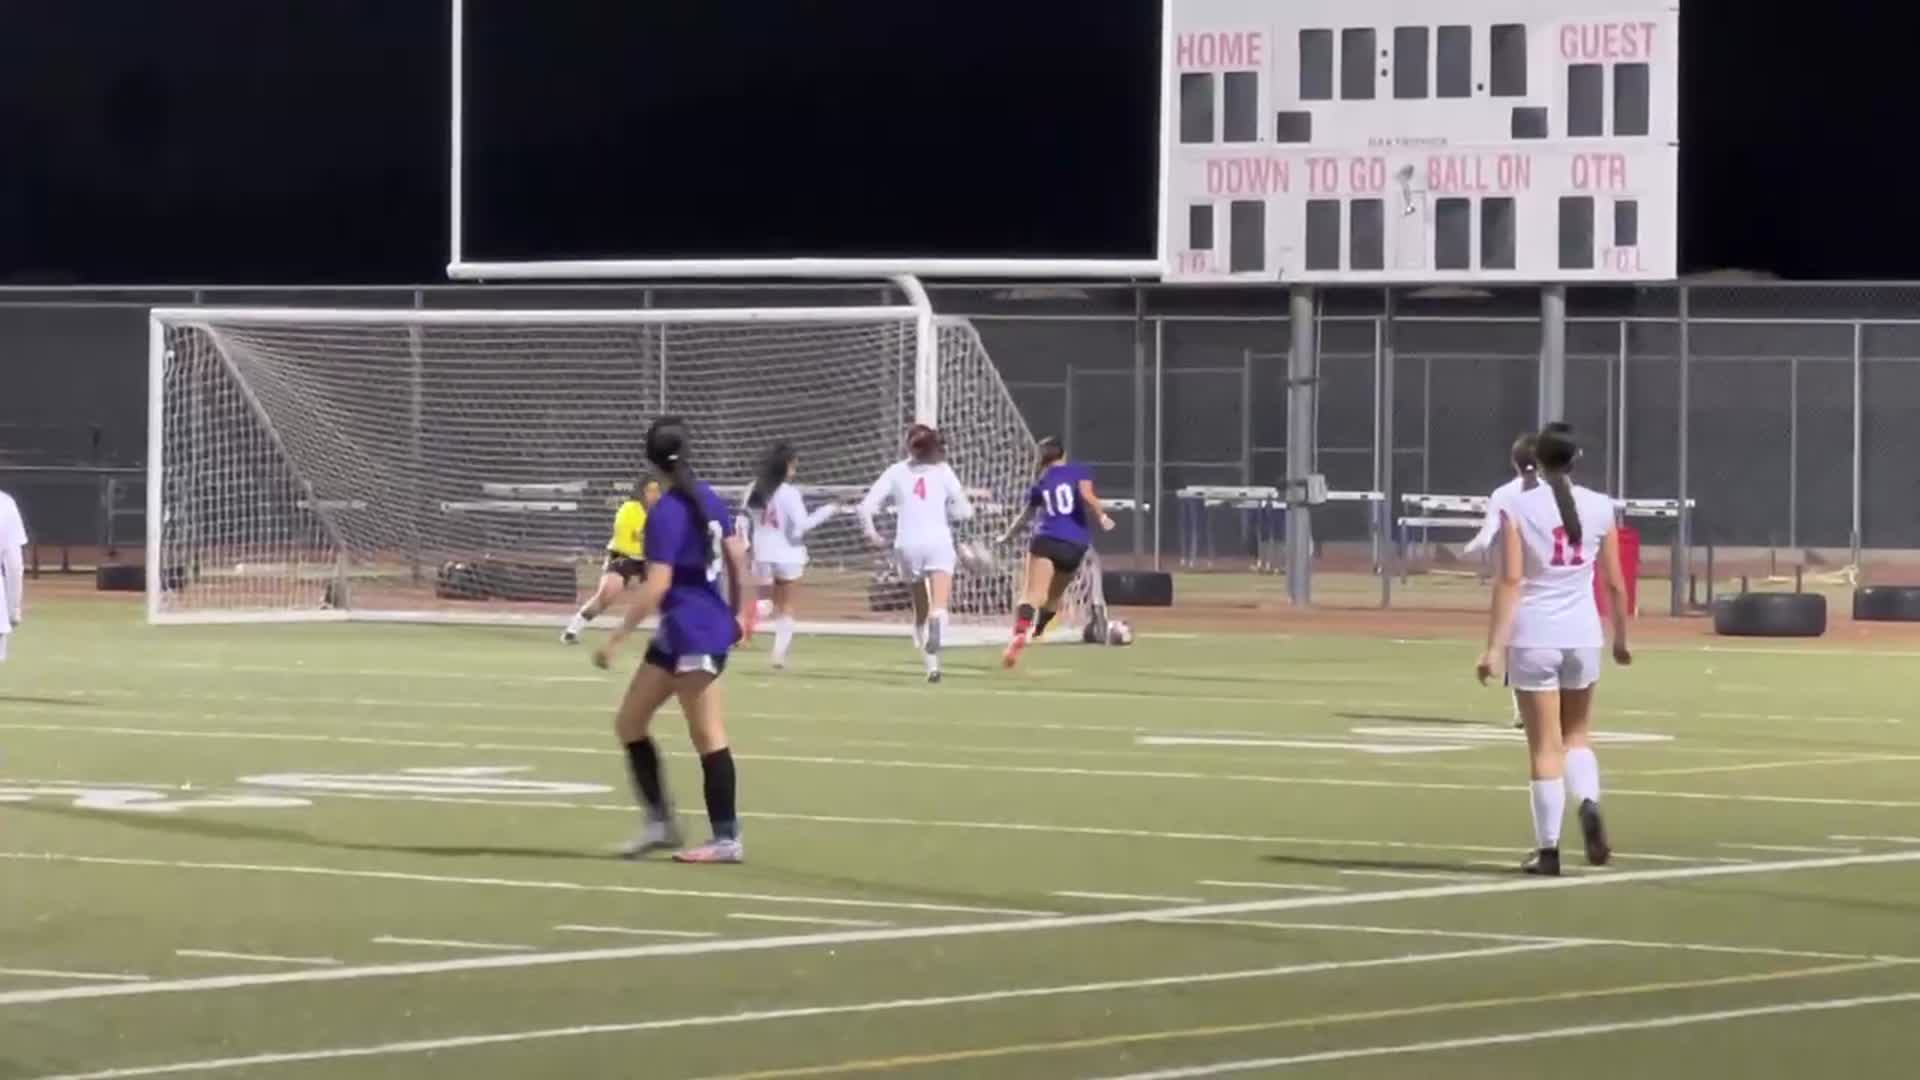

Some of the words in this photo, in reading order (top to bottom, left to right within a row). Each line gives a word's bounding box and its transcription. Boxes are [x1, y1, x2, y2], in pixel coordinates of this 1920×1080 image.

[1176, 31, 1263, 66] HOME
[1559, 22, 1656, 59] GUEST
[1206, 158, 1290, 194] DOWN
[1306, 157, 1338, 192] TO
[1350, 157, 1386, 192] GO
[1427, 155, 1488, 191] BALL
[1497, 154, 1531, 190] ON
[913, 477, 926, 500] 4
[1042, 483, 1074, 517] 10
